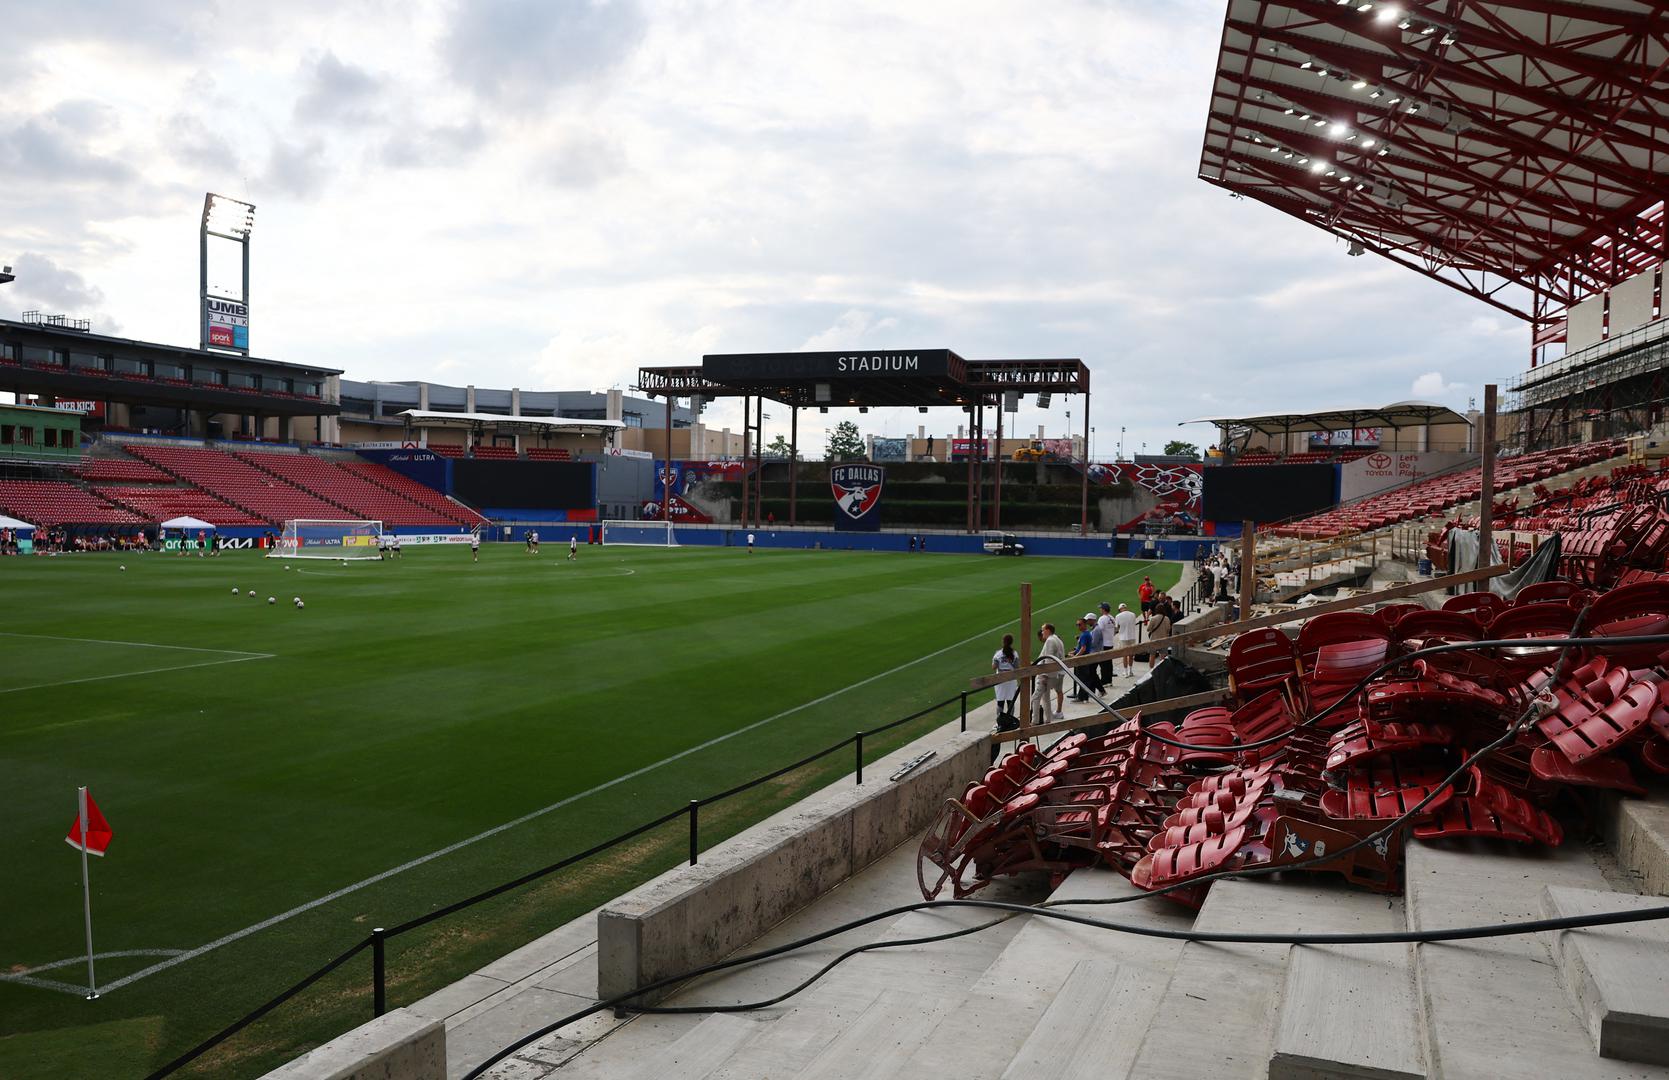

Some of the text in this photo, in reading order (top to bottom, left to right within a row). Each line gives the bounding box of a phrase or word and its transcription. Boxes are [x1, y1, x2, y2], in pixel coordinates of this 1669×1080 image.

[208, 300, 247, 316] UMB
[208, 313, 247, 326] BANK
[212, 333, 231, 342] spark
[838, 355, 919, 372] STADIUM
[76, 401, 96, 411] KICK
[1337, 431, 1349, 440] IN
[413, 454, 436, 462] ULTRA
[1399, 461, 1411, 469] Go
[834, 467, 879, 482] FC DALLAS
[165, 539, 207, 549] armc
[219, 537, 253, 549] KIA
